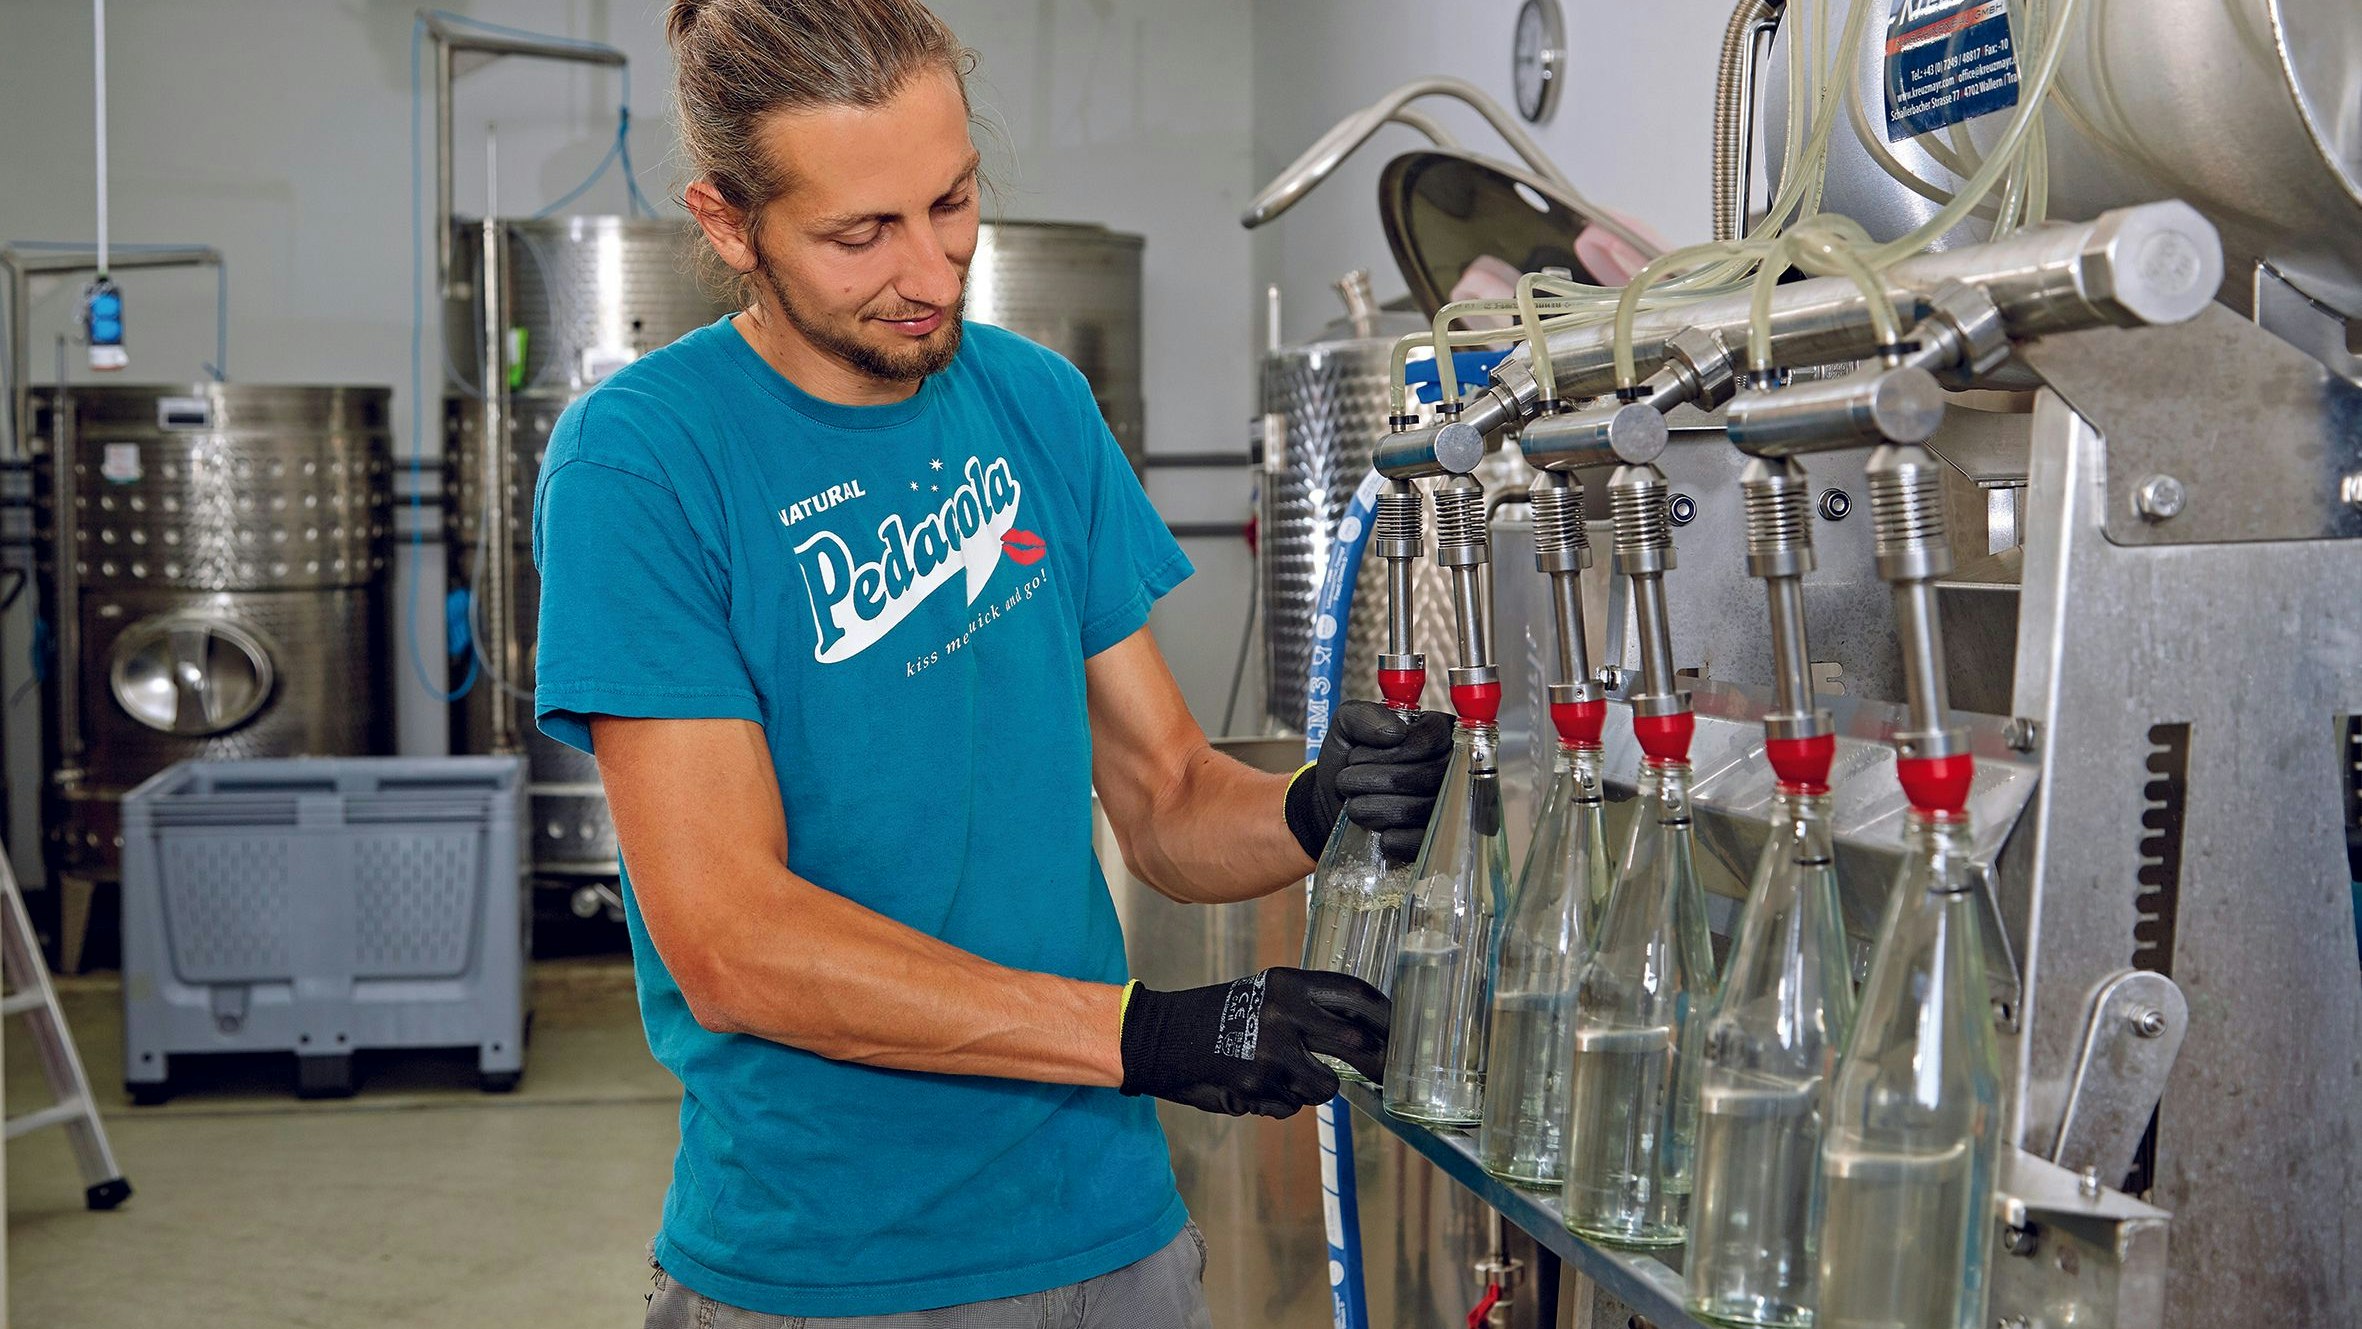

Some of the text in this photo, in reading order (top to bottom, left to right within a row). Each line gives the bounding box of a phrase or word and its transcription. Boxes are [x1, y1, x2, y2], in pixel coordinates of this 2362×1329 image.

[1923, 64, 1934, 77] +43
[1935, 60, 1943, 75] (0)
[1943, 55, 1958, 71] 7249
[1962, 47, 1981, 64] 48817
[1897, 76, 1955, 103] www.kreuzmayr.com
[1931, 94, 1952, 109] Strasse
[1952, 89, 1960, 102] 77
[1964, 83, 1979, 98] 4702
[1979, 77, 2004, 94] Wallern
[793, 455, 1021, 664] Pedacola
[905, 568, 1048, 678] kiss me uick and go!
